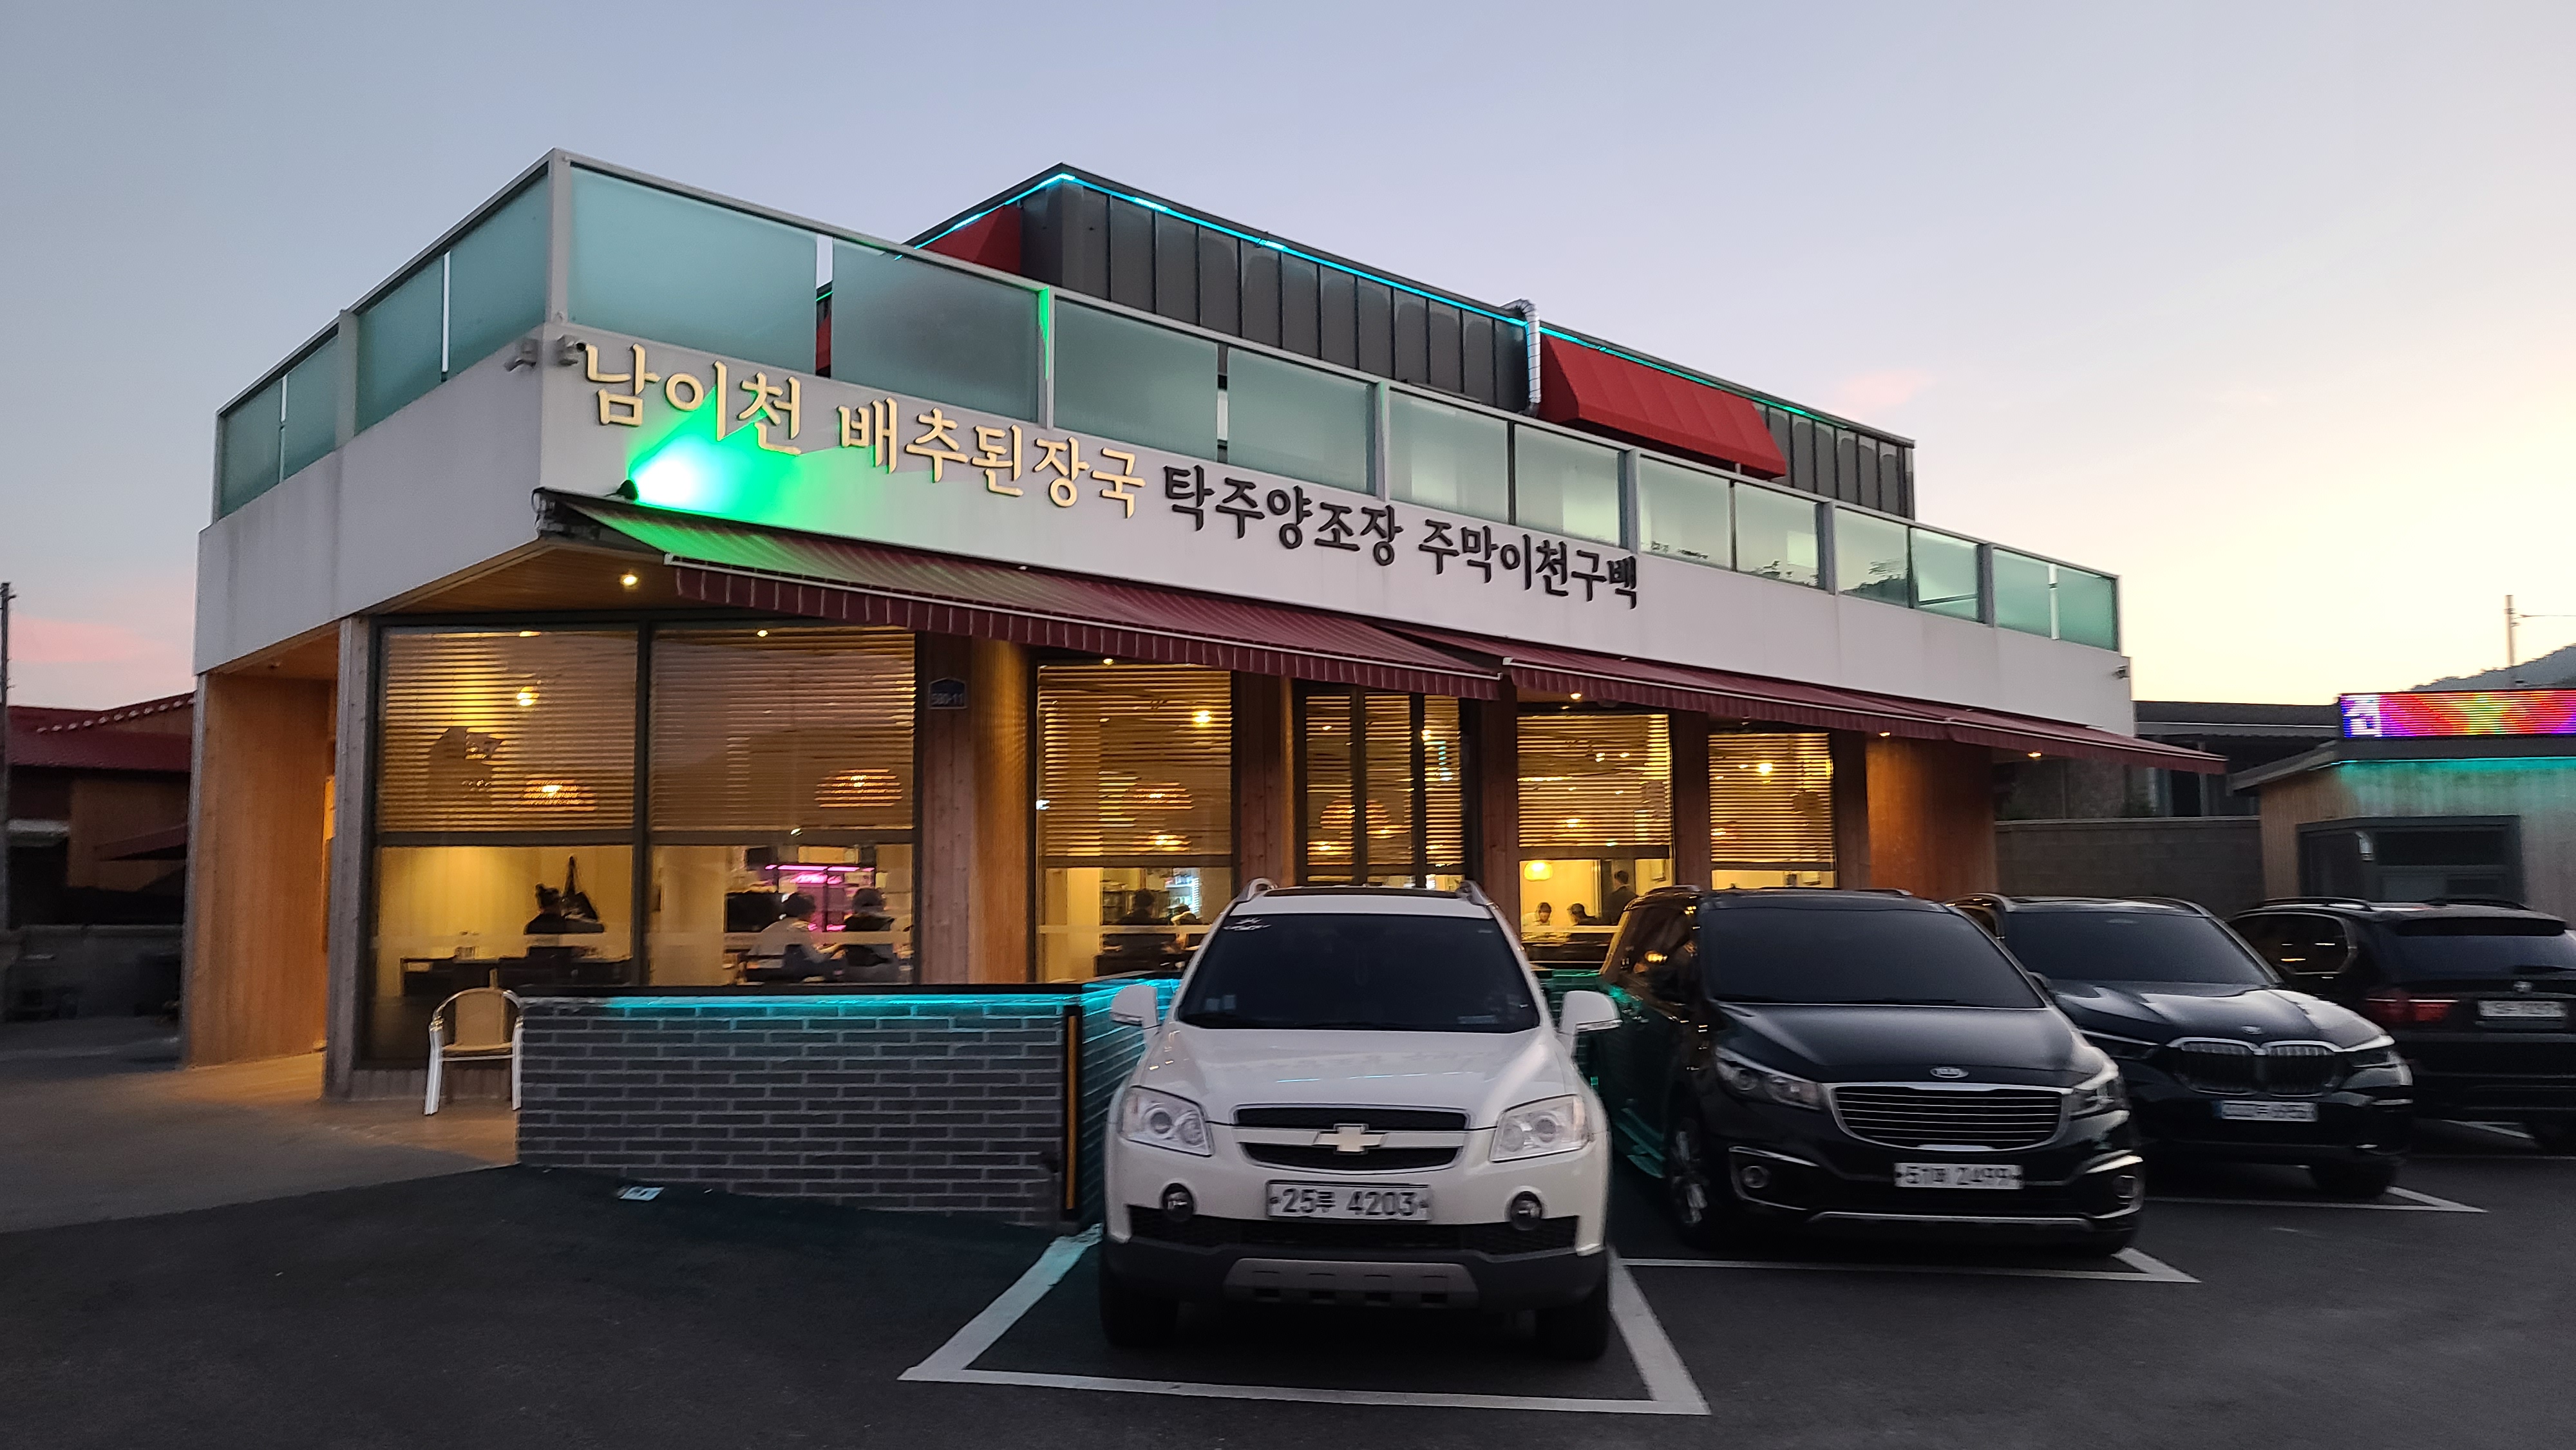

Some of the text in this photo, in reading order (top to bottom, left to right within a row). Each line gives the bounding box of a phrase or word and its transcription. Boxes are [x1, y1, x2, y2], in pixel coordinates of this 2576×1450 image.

[583, 343, 1639, 610] 남이천 배추된장국 탁주양조장 주막이천구백
[1346, 1191, 1417, 1216] 4203
